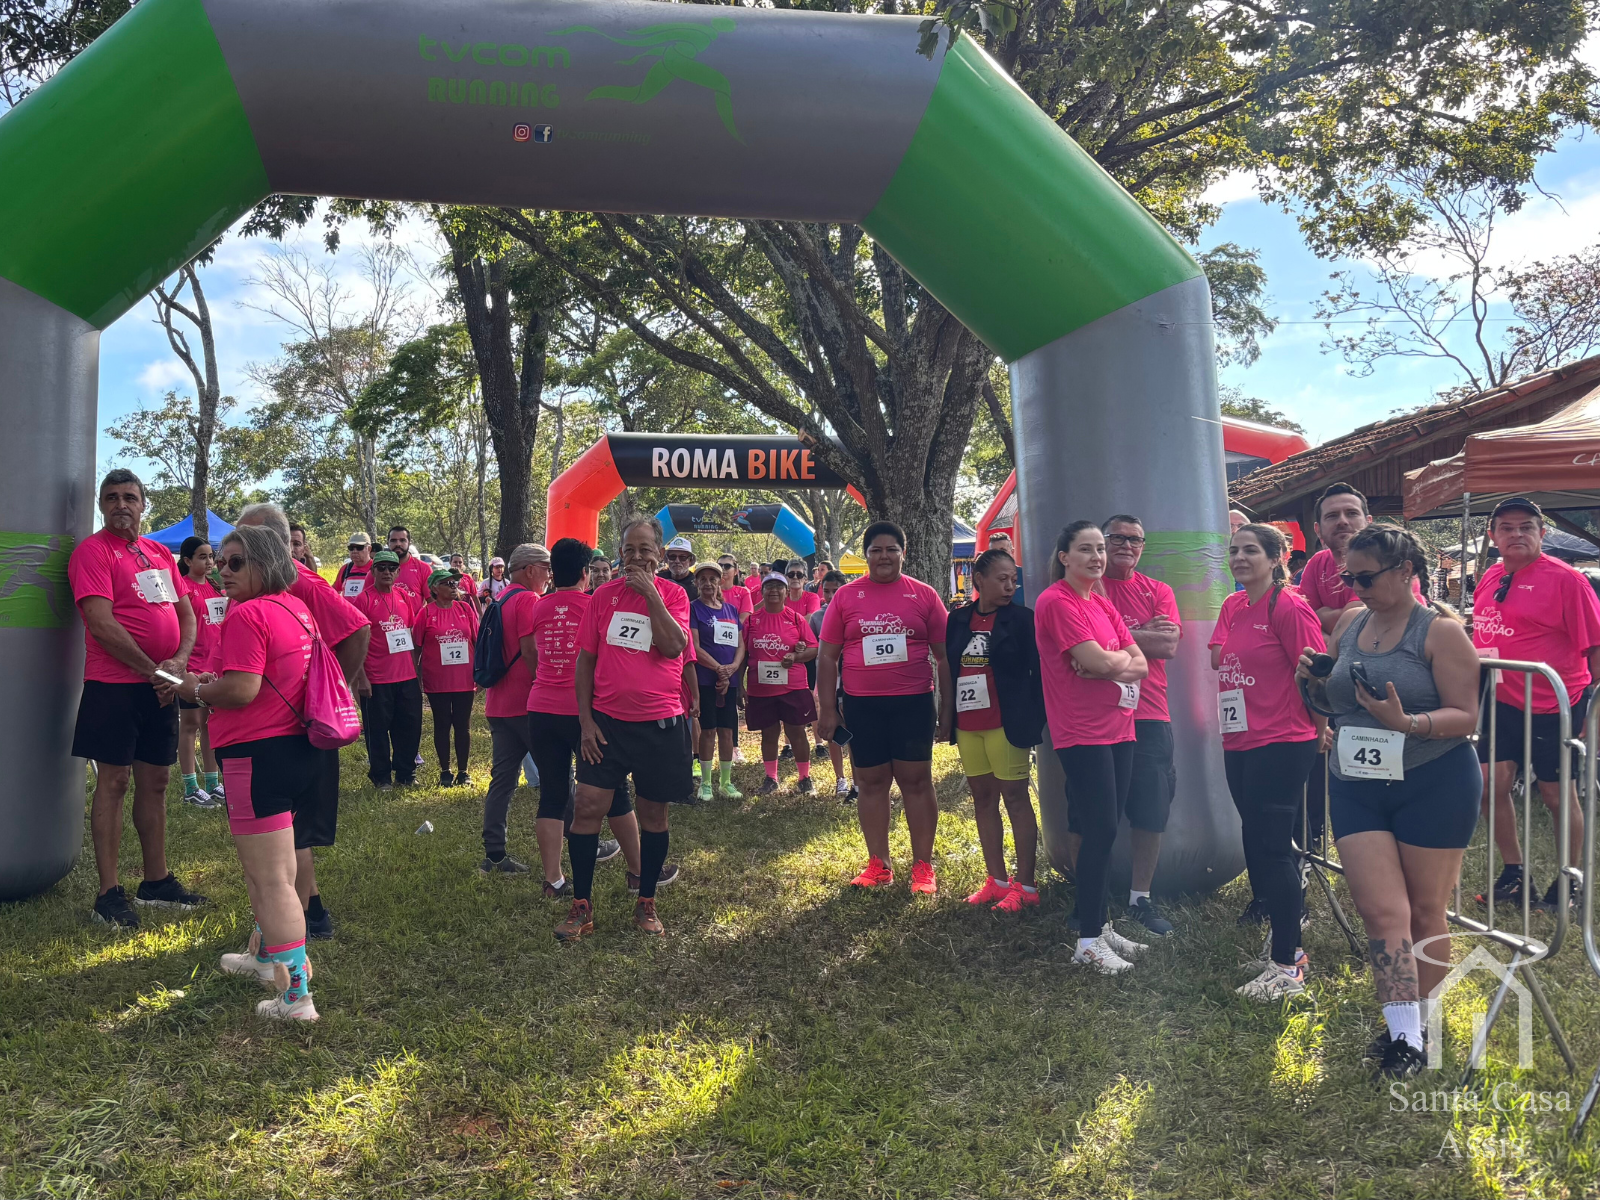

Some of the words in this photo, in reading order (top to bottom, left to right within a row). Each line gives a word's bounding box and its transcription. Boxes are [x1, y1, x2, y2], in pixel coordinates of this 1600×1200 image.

[419, 33, 570, 69] tvcom
[428, 77, 560, 109] RUNNING
[652, 447, 739, 479] ROMA
[748, 448, 816, 480] BIKE
[214, 606, 224, 615] 79
[618, 625, 640, 639] 27
[721, 631, 733, 640] 46
[395, 637, 407, 647] 28
[449, 650, 462, 659] 12
[876, 643, 894, 656] 50
[766, 670, 779, 679] 25
[960, 689, 977, 702] 22
[1125, 684, 1135, 698] 75
[1223, 706, 1238, 721] 72
[1351, 735, 1389, 743] CAMINHADA
[1353, 747, 1382, 766] 43
